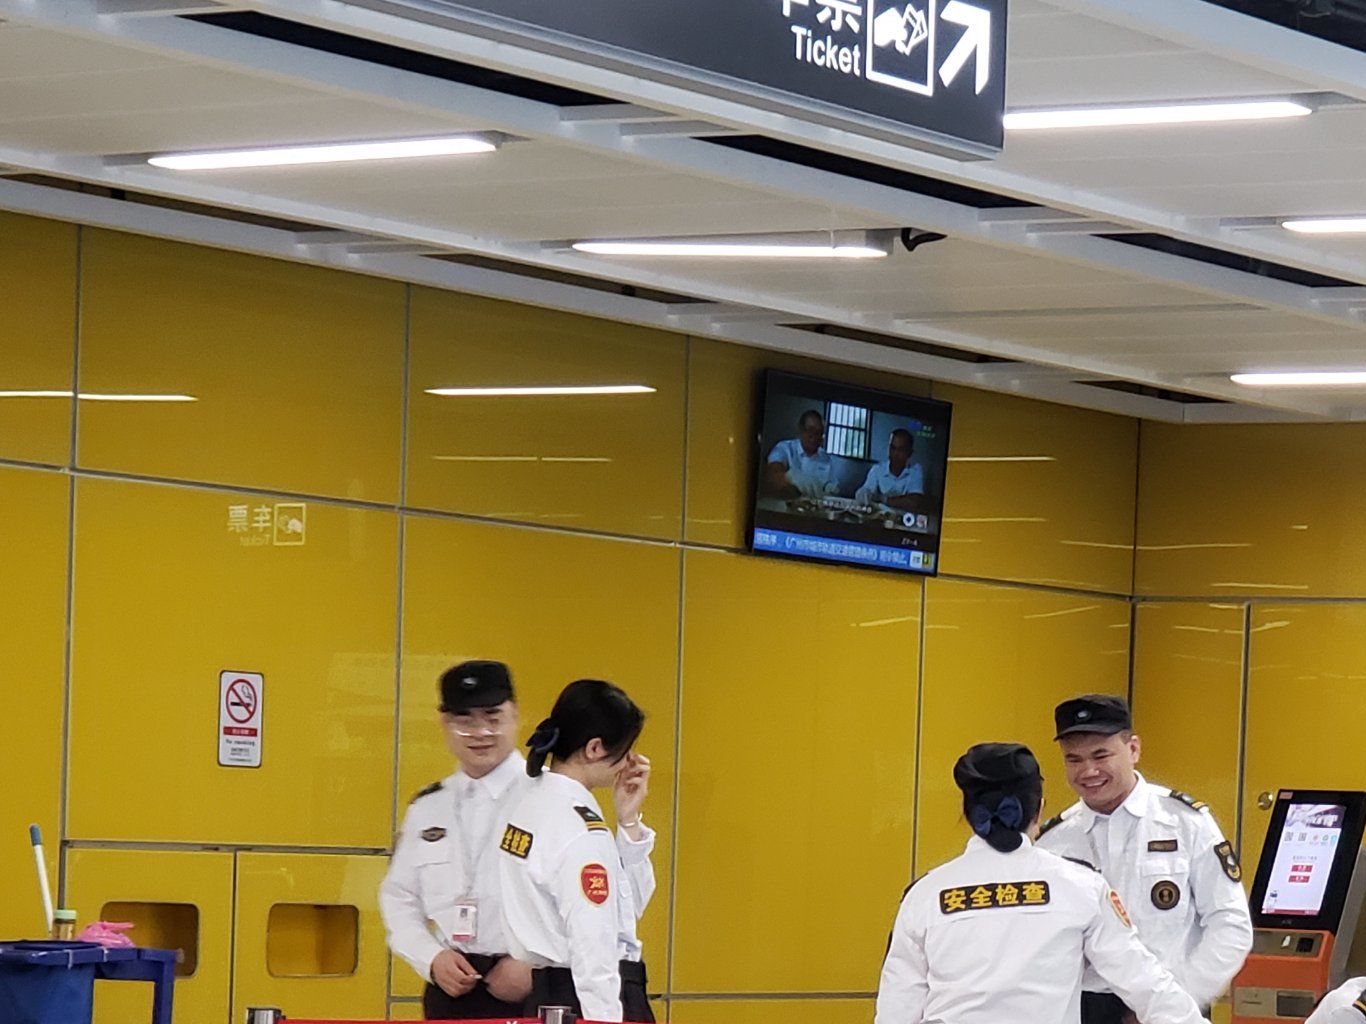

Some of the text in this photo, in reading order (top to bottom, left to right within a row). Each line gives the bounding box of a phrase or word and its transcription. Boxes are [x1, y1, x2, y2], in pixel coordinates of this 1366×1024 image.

[790, 24, 861, 77] Ticket
[943, 882, 1047, 911] 安全检查
